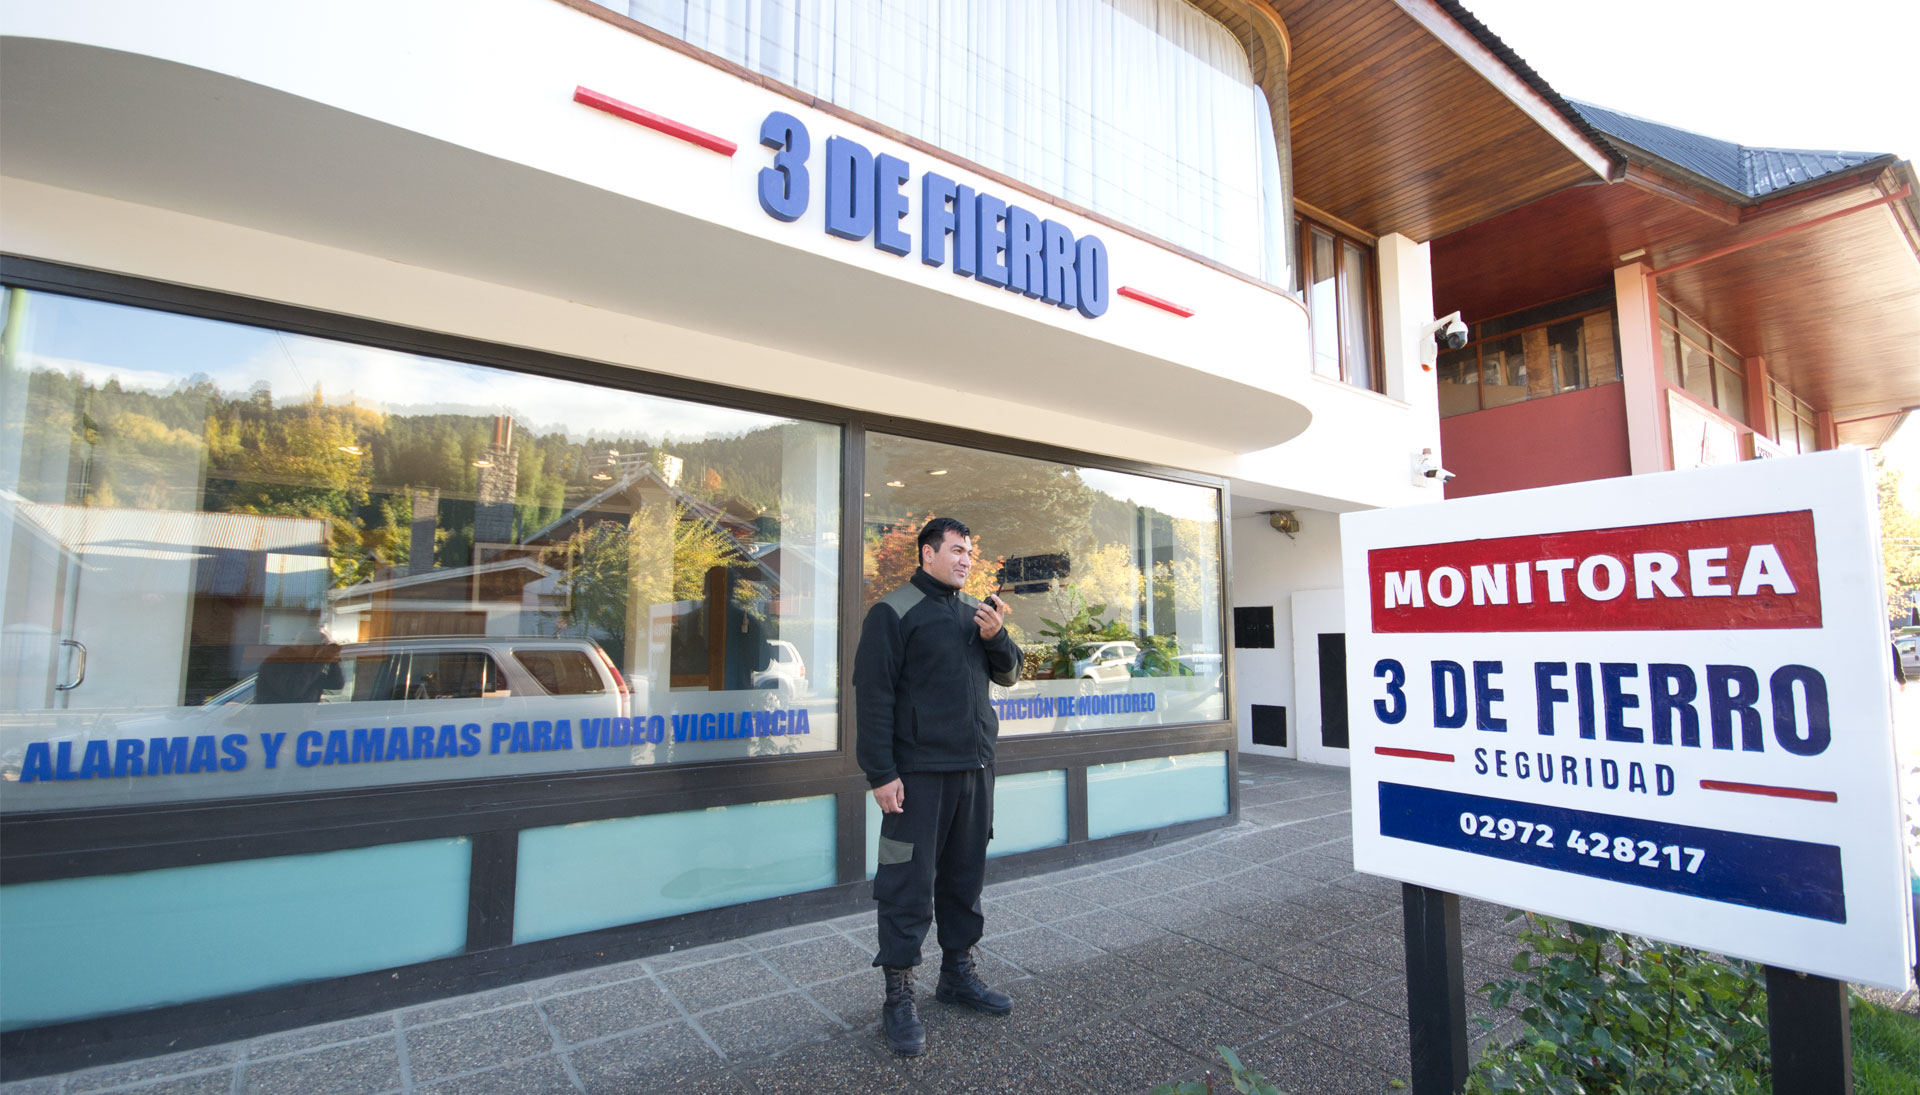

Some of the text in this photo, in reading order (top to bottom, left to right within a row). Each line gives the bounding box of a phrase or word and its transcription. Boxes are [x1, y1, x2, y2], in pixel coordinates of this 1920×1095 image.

[758, 111, 1109, 319] 3 DE FIERRO
[1384, 543, 1797, 609] MONITOREA
[1057, 696, 1076, 717] DE
[1079, 692, 1156, 716] MONITOREO
[1373, 658, 1832, 757] 3 DE FIERRO
[19, 709, 810, 783] ALARMAS Y CAMARAS PARA VIDEO VIGILANCIA
[1474, 747, 1676, 797] SEGURIDAD
[1459, 812, 1706, 875] 02972 428217
